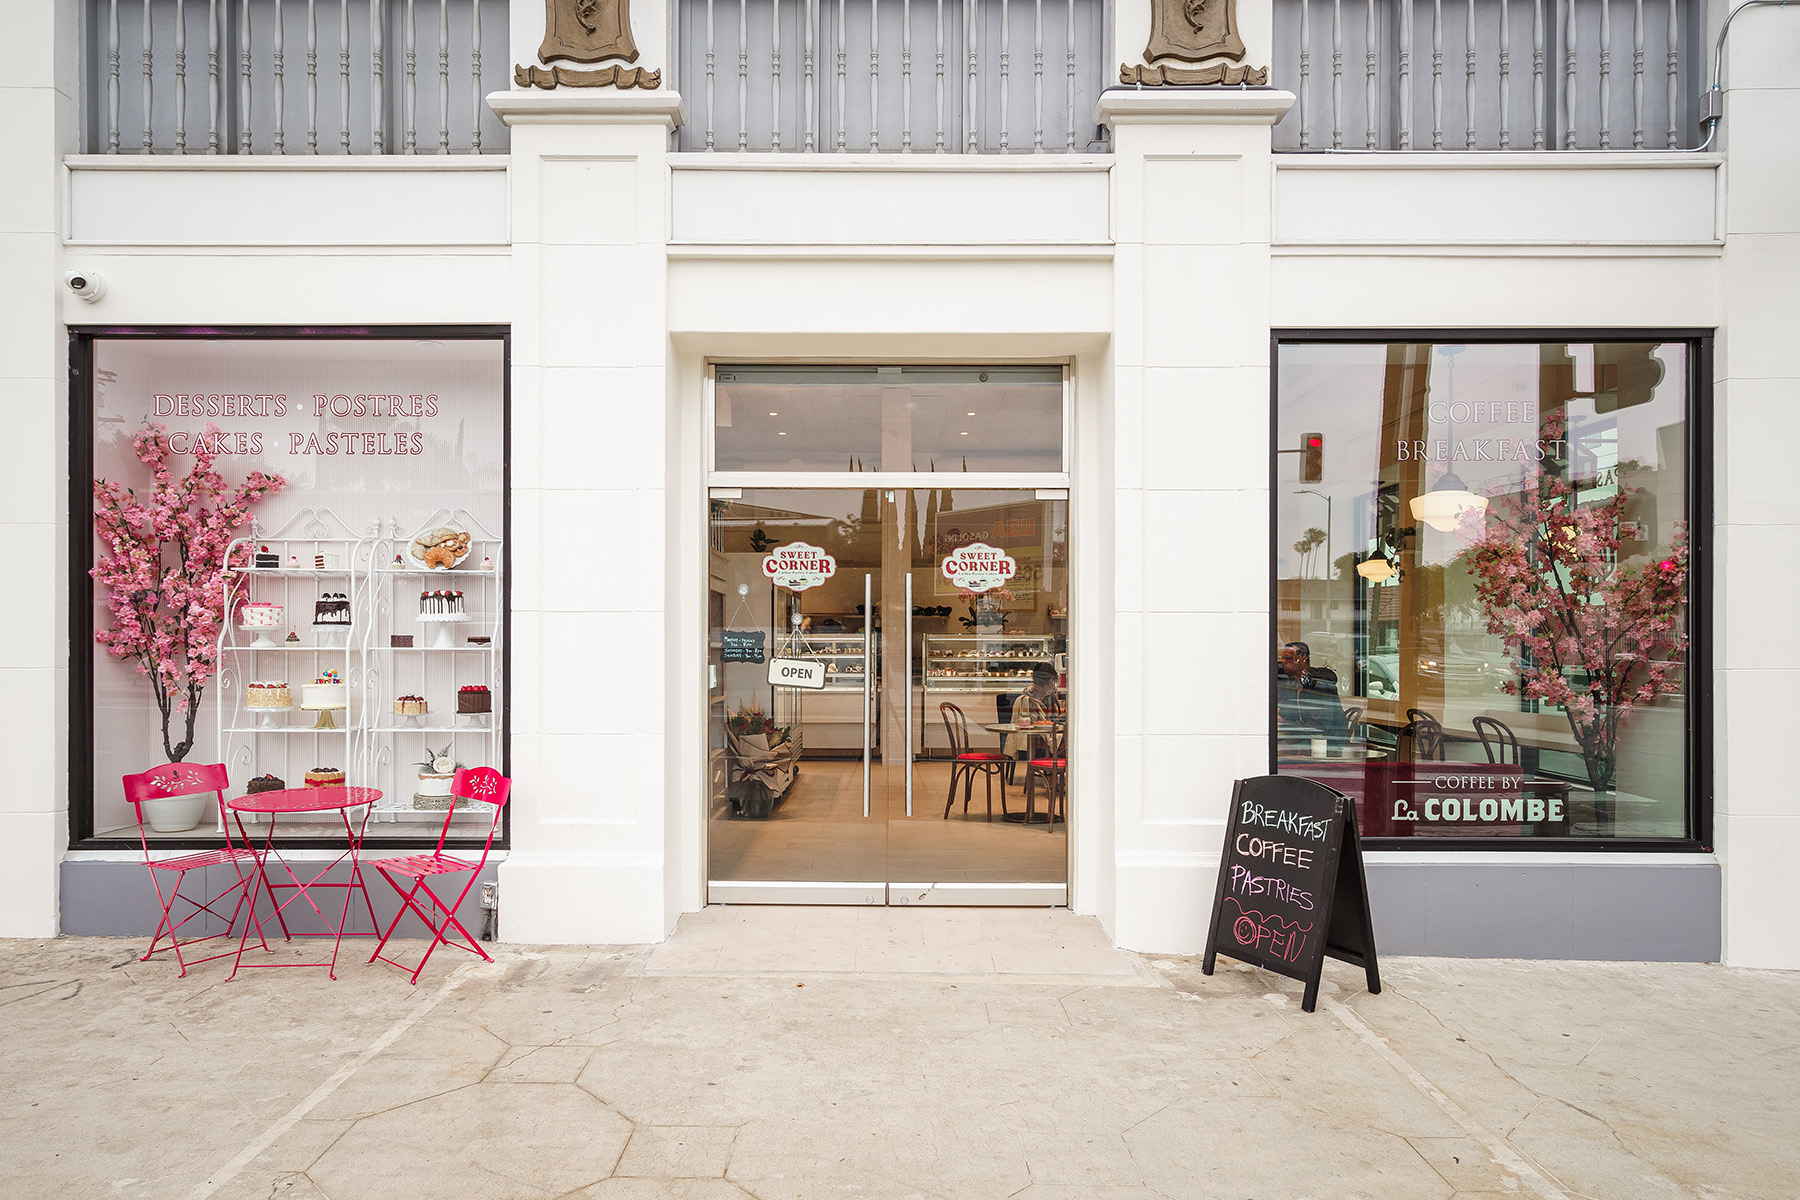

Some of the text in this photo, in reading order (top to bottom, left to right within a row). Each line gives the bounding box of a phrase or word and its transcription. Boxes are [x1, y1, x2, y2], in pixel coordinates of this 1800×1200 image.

[153, 394, 438, 417] DESSERTS POSTRES
[1428, 401, 1535, 424] COFFEE
[168, 432, 423, 455] CAKES PASTELES
[1396, 439, 1567, 461] BREAKFAST
[766, 559, 831, 573] CORNER
[780, 551, 817, 559] SWEET
[960, 552, 997, 560] SWEET
[946, 560, 1011, 574] CORNER
[781, 667, 812, 679] OPEN
[1435, 776, 1521, 789] COFFEE BY
[1241, 800, 1332, 842] BREAKFAST
[1391, 799, 1564, 821] La COLOMBE
[1236, 833, 1314, 869] COFFEE
[1231, 864, 1314, 910] PASTRIES
[1233, 916, 1307, 962] OPEN
